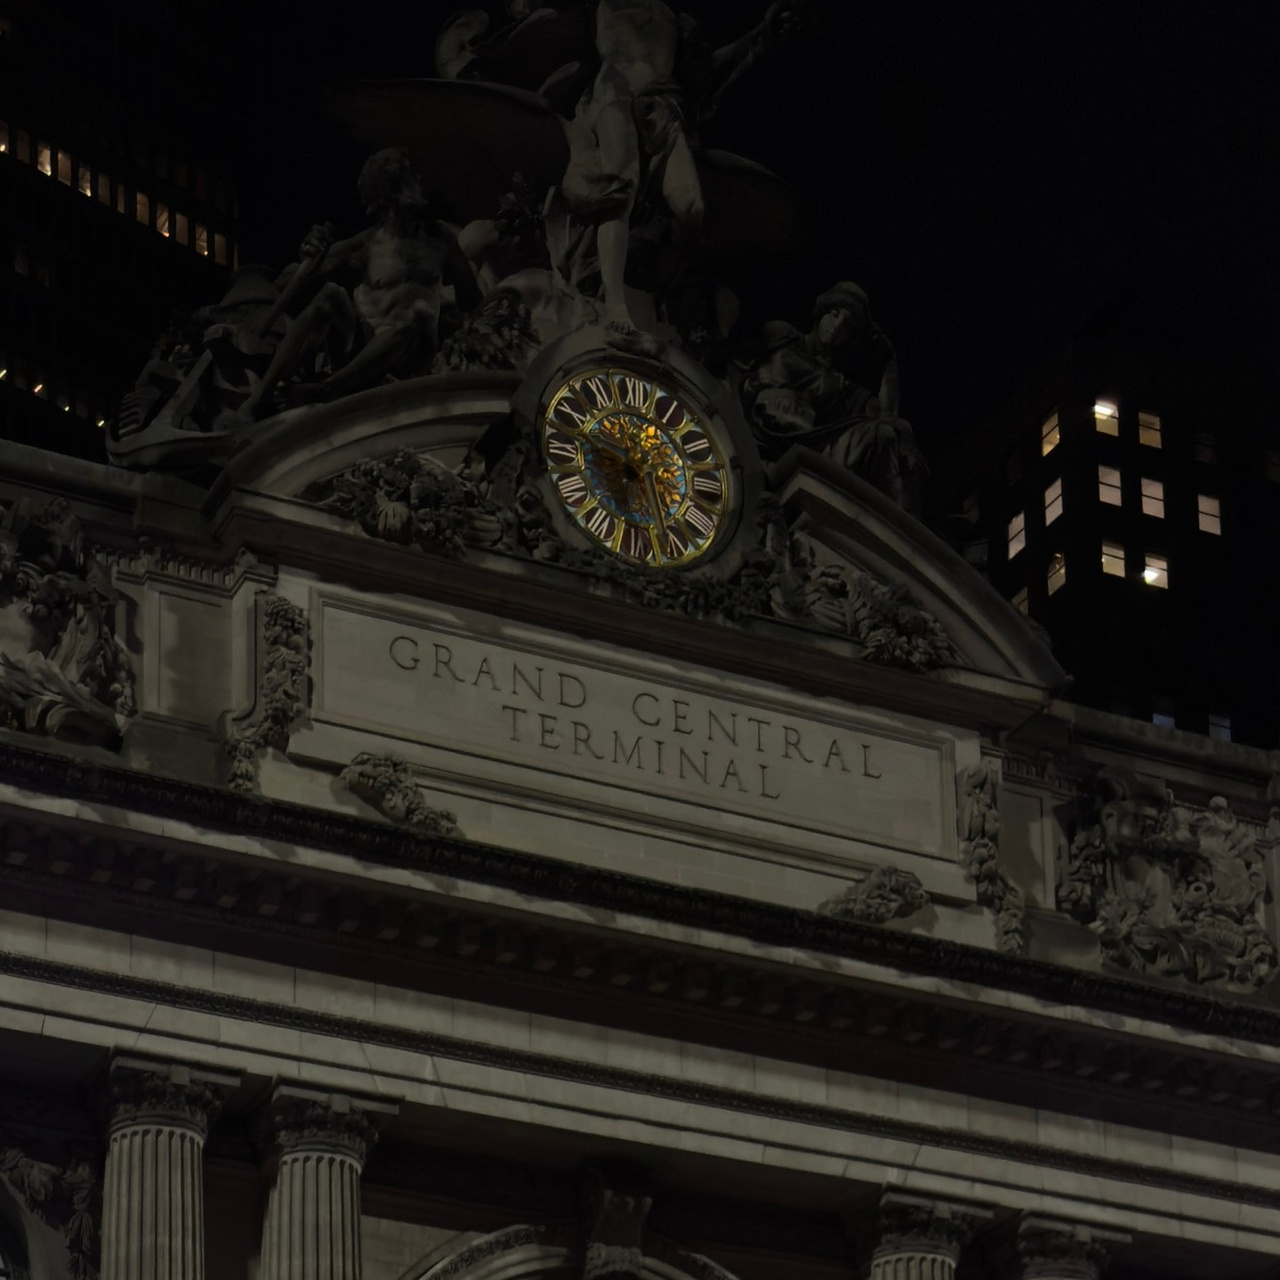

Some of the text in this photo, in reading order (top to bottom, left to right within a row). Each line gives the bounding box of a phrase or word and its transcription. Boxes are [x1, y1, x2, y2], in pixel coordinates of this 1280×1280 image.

[389, 635, 883, 780] GRAND CENTRAL
[501, 704, 781, 800] TERMINAL
